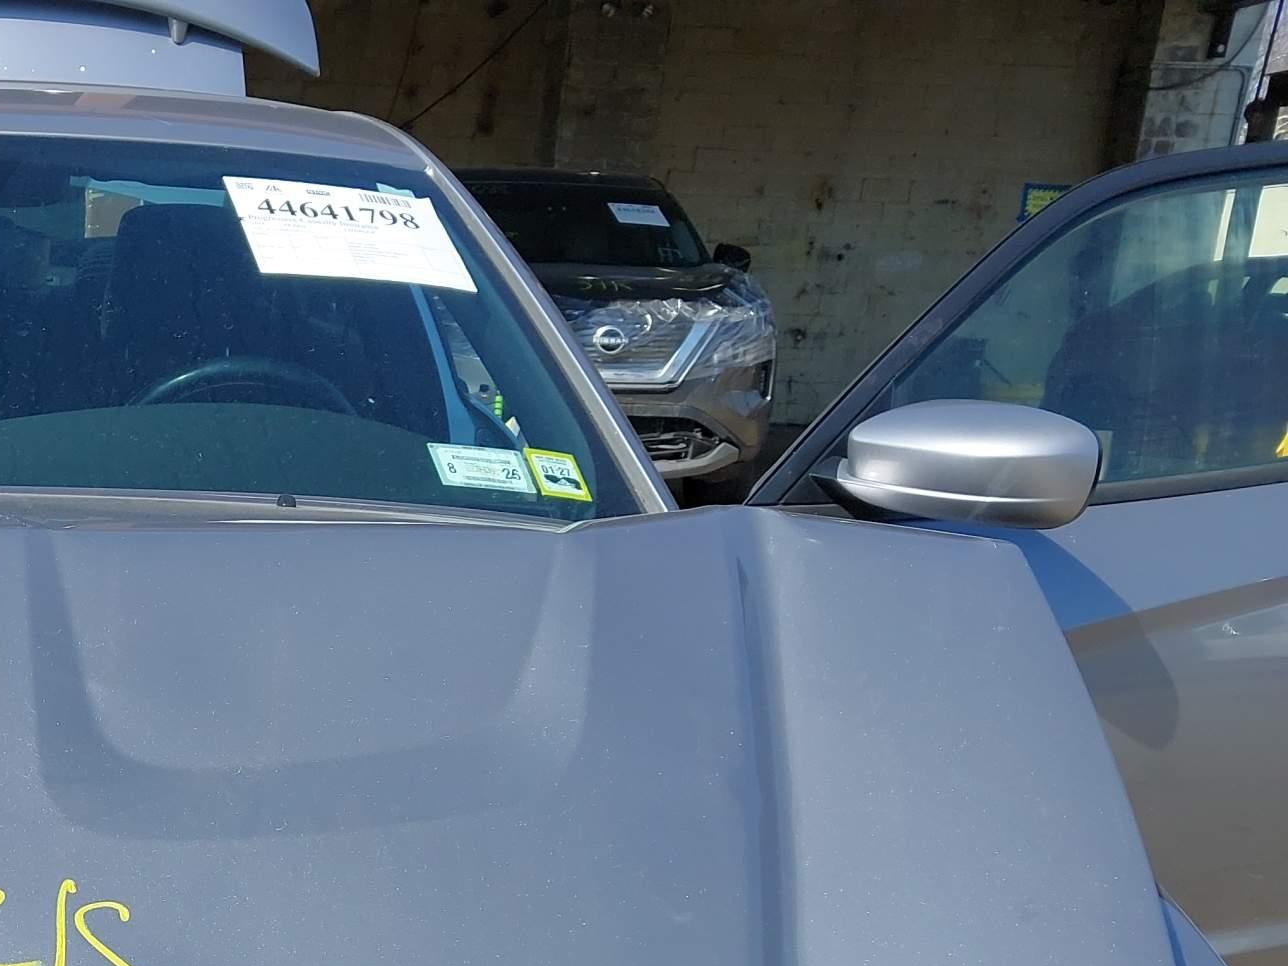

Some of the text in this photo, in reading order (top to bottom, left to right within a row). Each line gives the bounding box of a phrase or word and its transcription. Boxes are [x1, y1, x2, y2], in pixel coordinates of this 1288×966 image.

[257, 198, 420, 230] 44641798
[592, 336, 629, 345] NISSAN
[447, 463, 456, 473] 8
